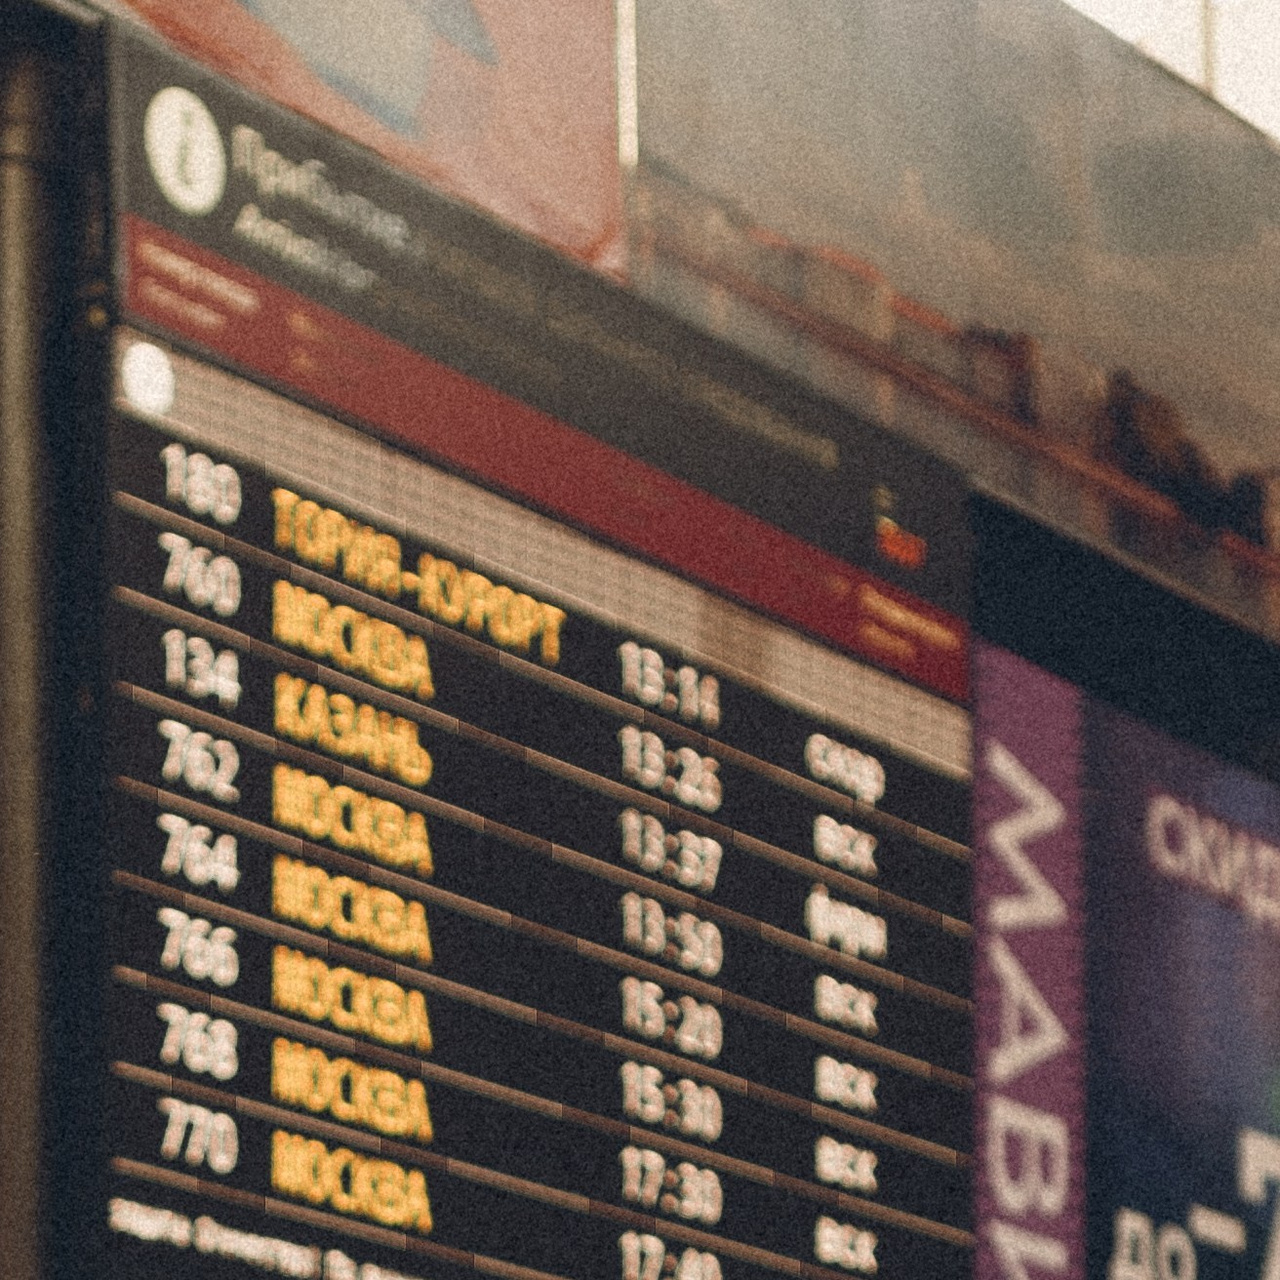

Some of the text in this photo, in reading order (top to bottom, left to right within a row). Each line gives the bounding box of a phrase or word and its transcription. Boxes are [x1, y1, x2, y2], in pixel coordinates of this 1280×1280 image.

[162, 629, 241, 709] 134
[273, 672, 433, 786] КАЗАНЬ
[272, 579, 434, 699] МОСКВА
[619, 725, 722, 813] 13:25
[158, 718, 239, 802] 762
[272, 763, 433, 876] МОСКВА
[157, 812, 240, 891] 764
[272, 854, 433, 964] МОСКВА
[157, 906, 239, 987] 766
[272, 945, 433, 1052] МОСКВА
[159, 1096, 239, 1175] 770
[272, 1129, 433, 1233] МОСКВА
[272, 1037, 433, 1142] МОСКВА
